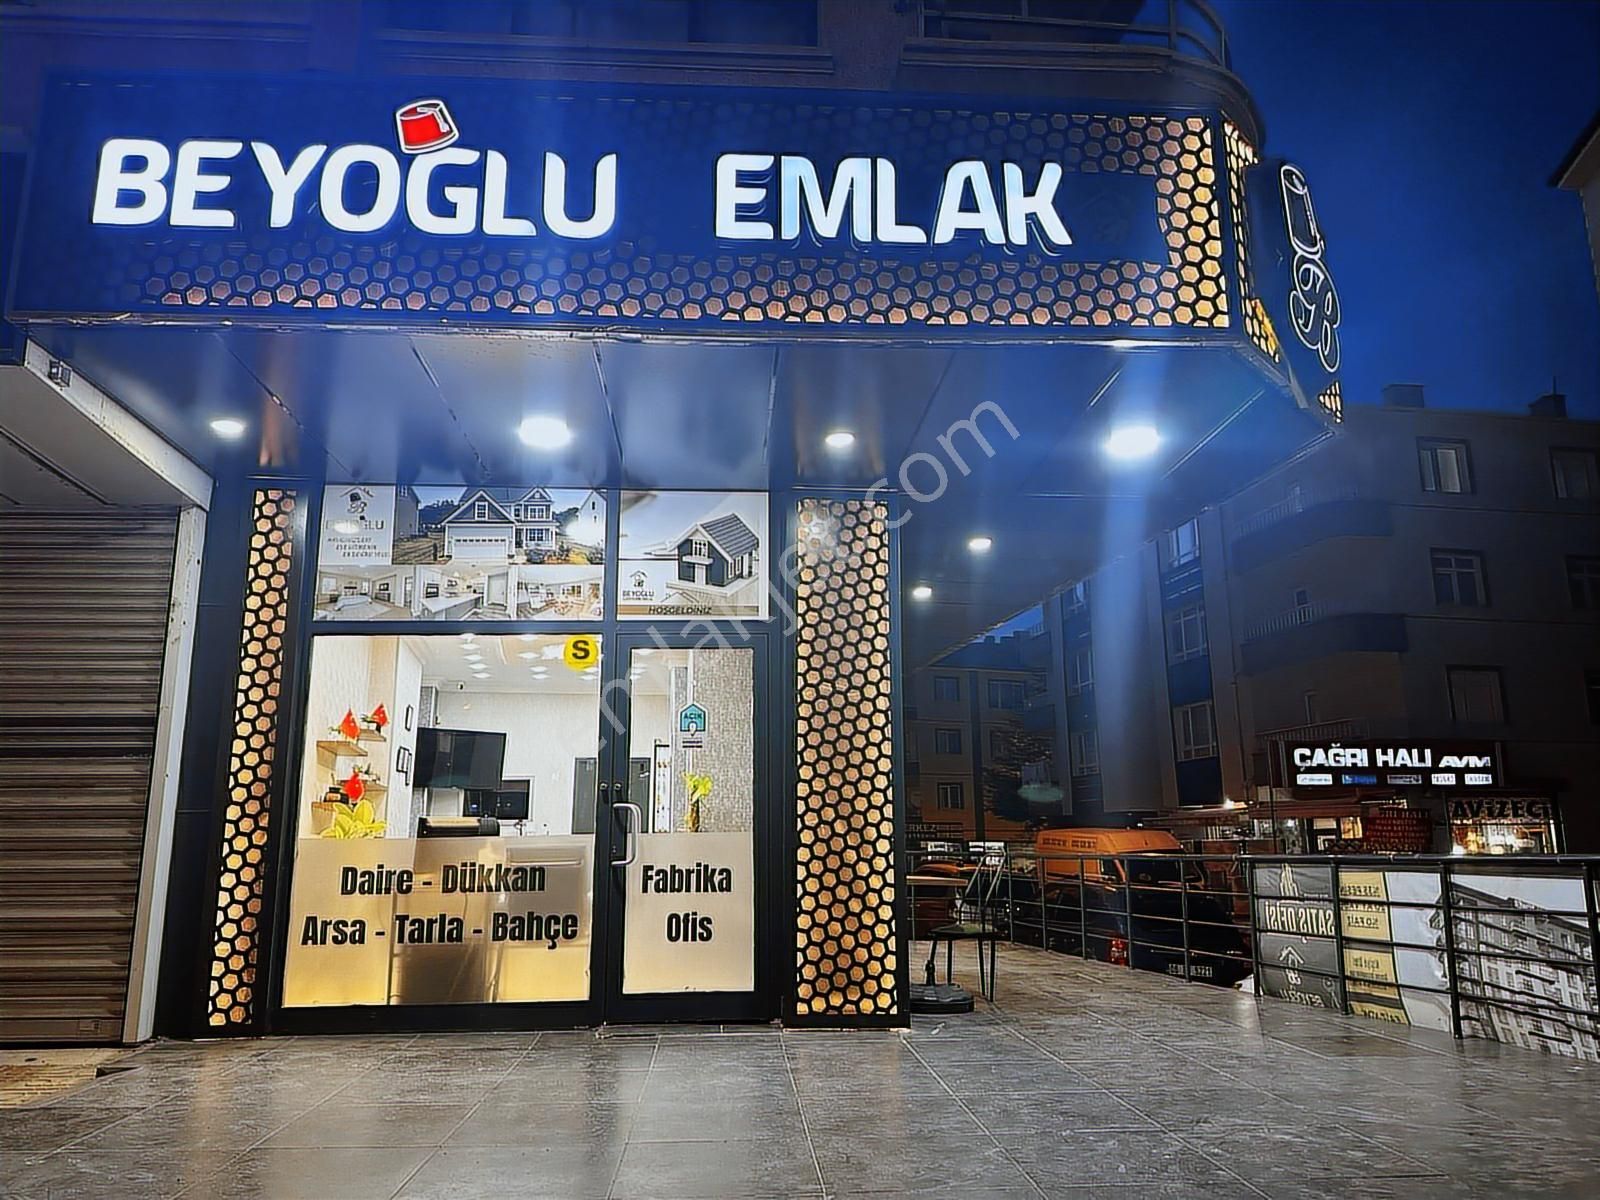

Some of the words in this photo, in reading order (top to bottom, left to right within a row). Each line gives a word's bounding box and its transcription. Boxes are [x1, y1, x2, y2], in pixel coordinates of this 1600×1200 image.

[714, 152, 1073, 248] EMLAK
[572, 640, 590, 660] S
[1294, 742, 1369, 772] ÇAĞRI
[1376, 748, 1432, 768] HALI
[1439, 756, 1491, 768] AVM
[341, 866, 413, 896] Daire
[442, 862, 546, 895] Dükkan
[642, 863, 732, 895] Fabrika
[302, 917, 366, 946] Arsa
[395, 913, 464, 944] Tarla
[492, 912, 578, 950] Bahçe
[667, 912, 713, 943] Ofis
